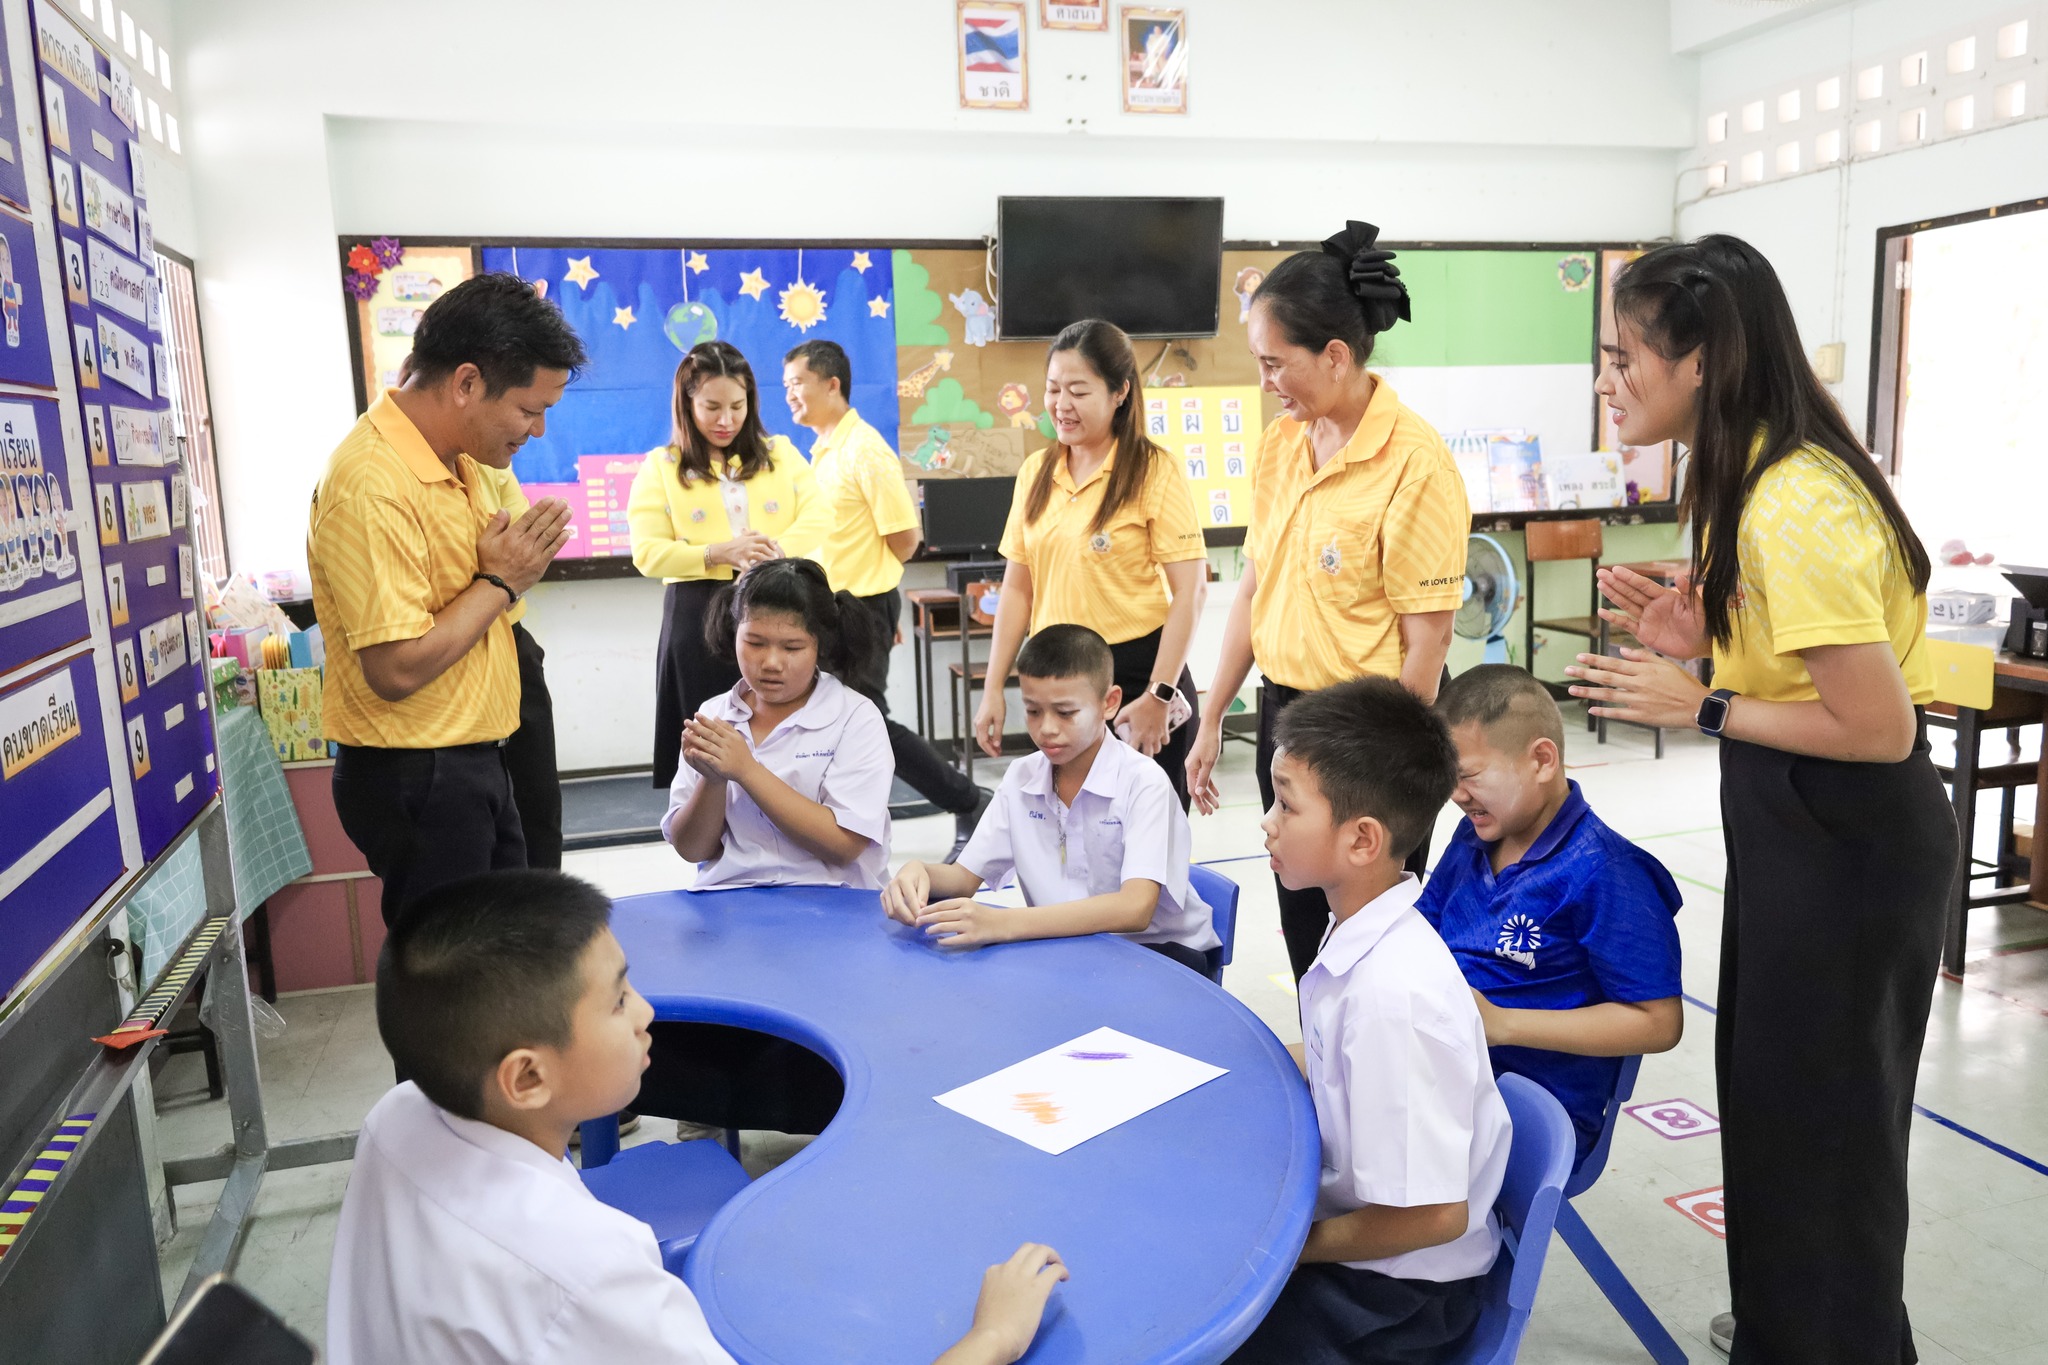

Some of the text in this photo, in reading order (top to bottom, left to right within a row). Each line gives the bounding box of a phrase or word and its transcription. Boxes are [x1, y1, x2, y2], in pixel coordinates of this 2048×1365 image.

[41, 26, 97, 96] ตารางเรียน
[979, 80, 1010, 98] ชาติ
[53, 97, 61, 134] 1
[61, 173, 72, 212] 2
[71, 253, 82, 291] 3
[83, 338, 93, 375] 4
[93, 417, 103, 453] 5
[104, 495, 113, 531] 6
[112, 576, 121, 612] 7
[1431, 577, 1448, 586] LOVE
[123, 652, 134, 687] 8
[3, 692, 77, 768] คนขาดเรียน
[134, 729, 144, 764] 9
